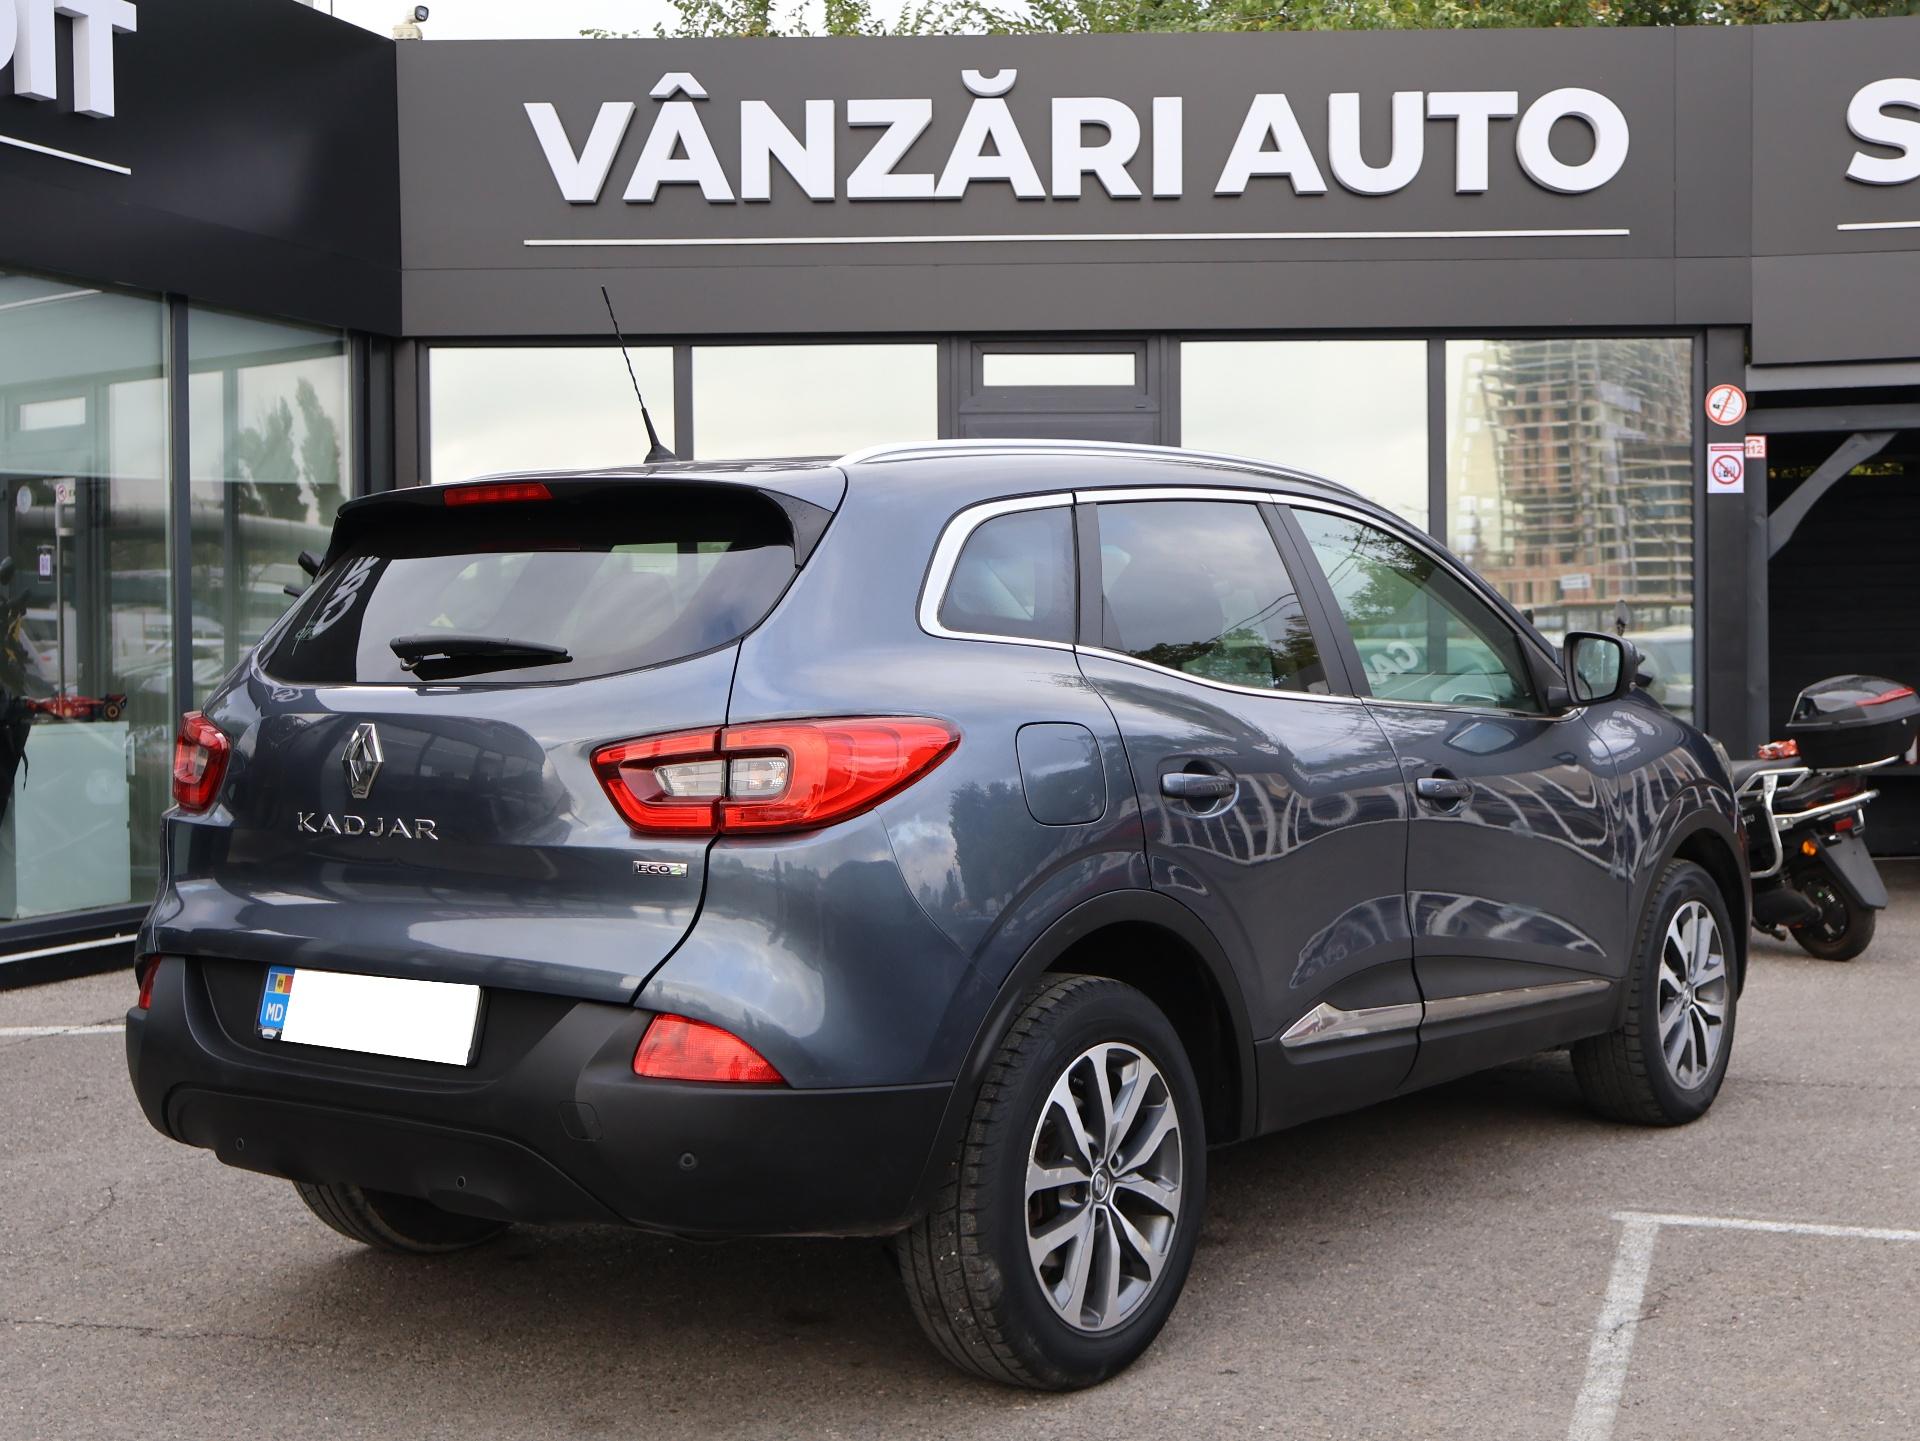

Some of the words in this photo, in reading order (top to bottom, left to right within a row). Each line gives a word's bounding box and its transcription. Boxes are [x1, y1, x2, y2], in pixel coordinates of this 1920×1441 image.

[0, 0, 137, 118] IT
[523, 69, 1183, 204] VÂNZĂRI
[1214, 87, 1631, 197] AUTO
[1745, 445, 1763, 454] 112
[297, 811, 439, 841] KADJAR
[265, 1001, 284, 1022] MD
